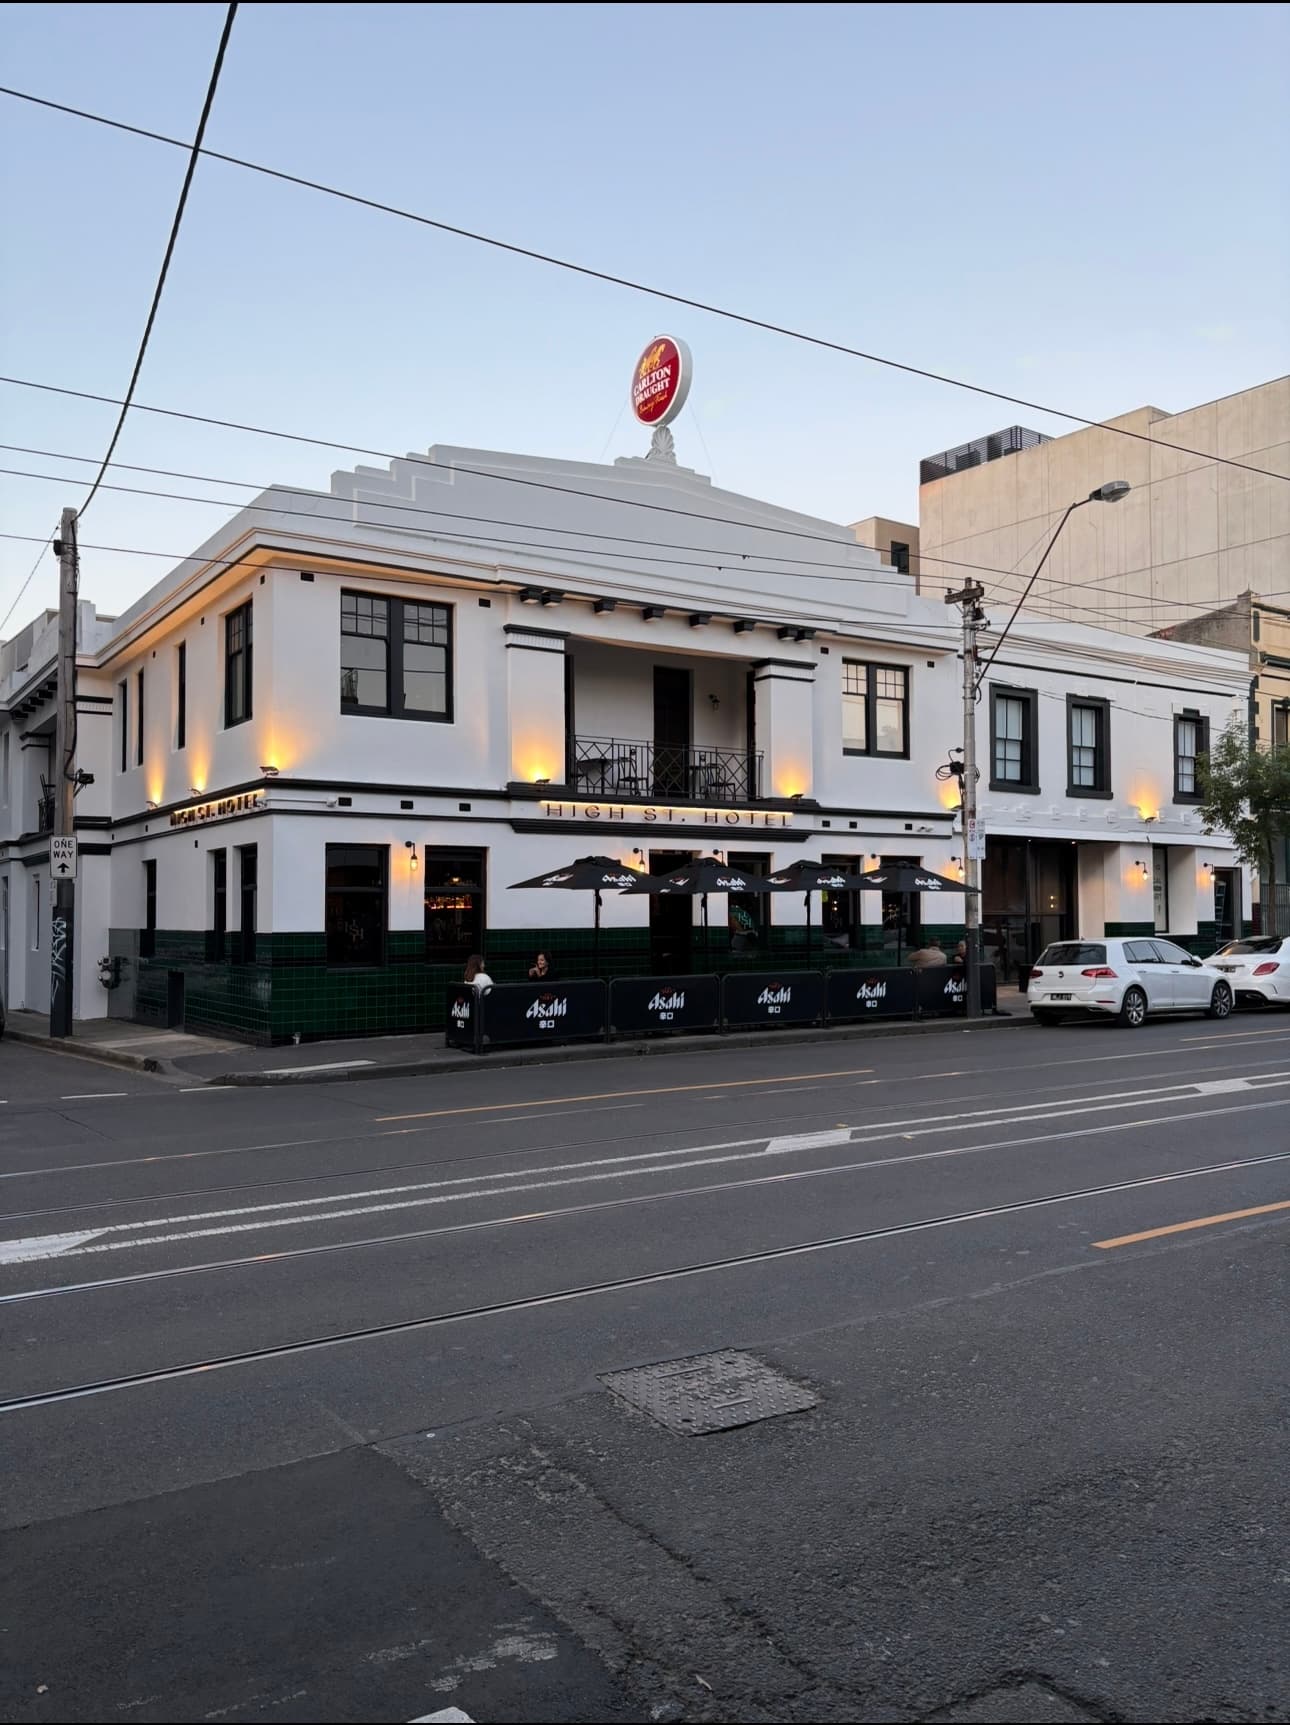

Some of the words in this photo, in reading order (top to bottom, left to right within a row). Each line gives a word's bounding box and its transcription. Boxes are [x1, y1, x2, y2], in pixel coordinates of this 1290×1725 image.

[634, 364, 671, 397] CARLTON
[635, 377, 671, 407] DRAUGHT
[546, 803, 624, 820] HIGH
[643, 807, 686, 822] ST.
[704, 811, 793, 827] HOTEL
[53, 839, 74, 849] ONE
[52, 850, 74, 859] WAY
[757, 986, 792, 1004] Asahi
[856, 981, 887, 999] Asahi
[943, 977, 968, 994] Asah
[451, 1000, 470, 1019] Asahi
[525, 997, 567, 1019] Asahi
[647, 991, 685, 1010] Asahi
